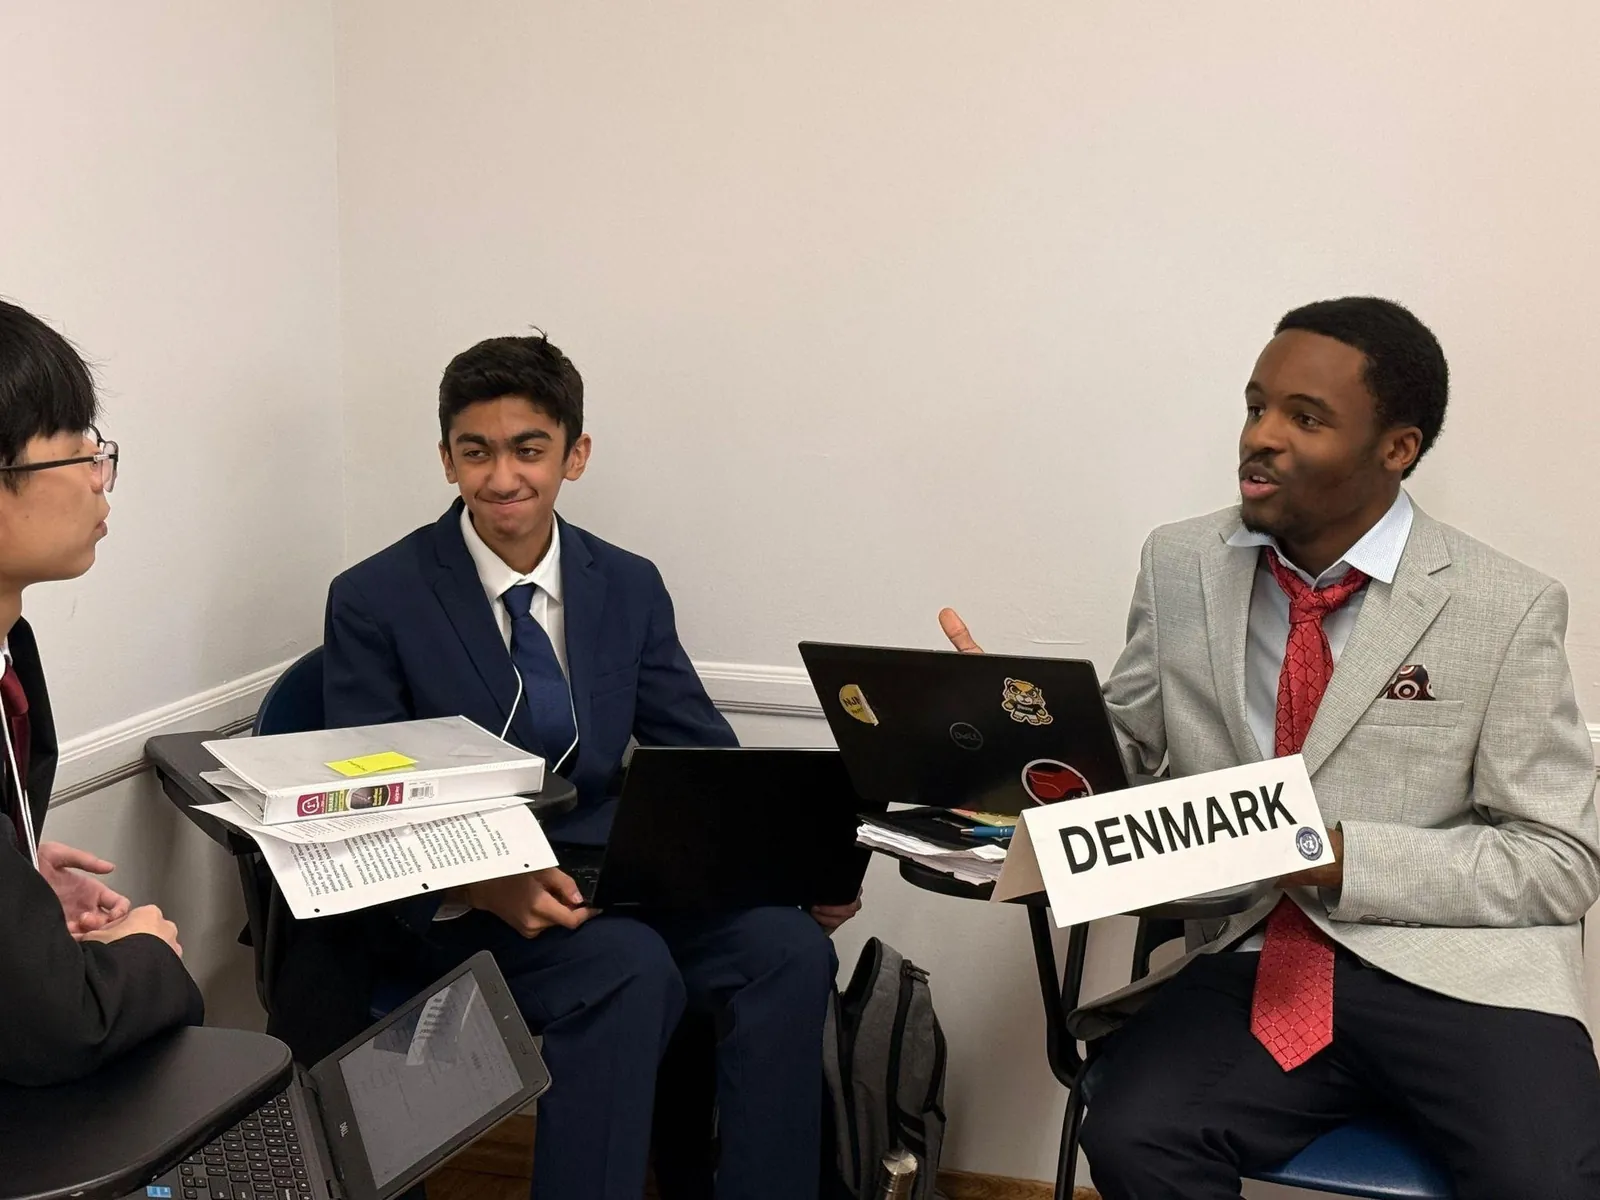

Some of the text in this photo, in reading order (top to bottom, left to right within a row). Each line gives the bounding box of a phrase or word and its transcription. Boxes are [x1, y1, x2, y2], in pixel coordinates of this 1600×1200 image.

[954, 731, 980, 740] DELL
[1058, 782, 1297, 874] DENMARK
[387, 858, 399, 878] Denmark
[424, 849, 437, 869] Denmark
[356, 864, 368, 885] Denmark
[371, 861, 384, 881] Denmark
